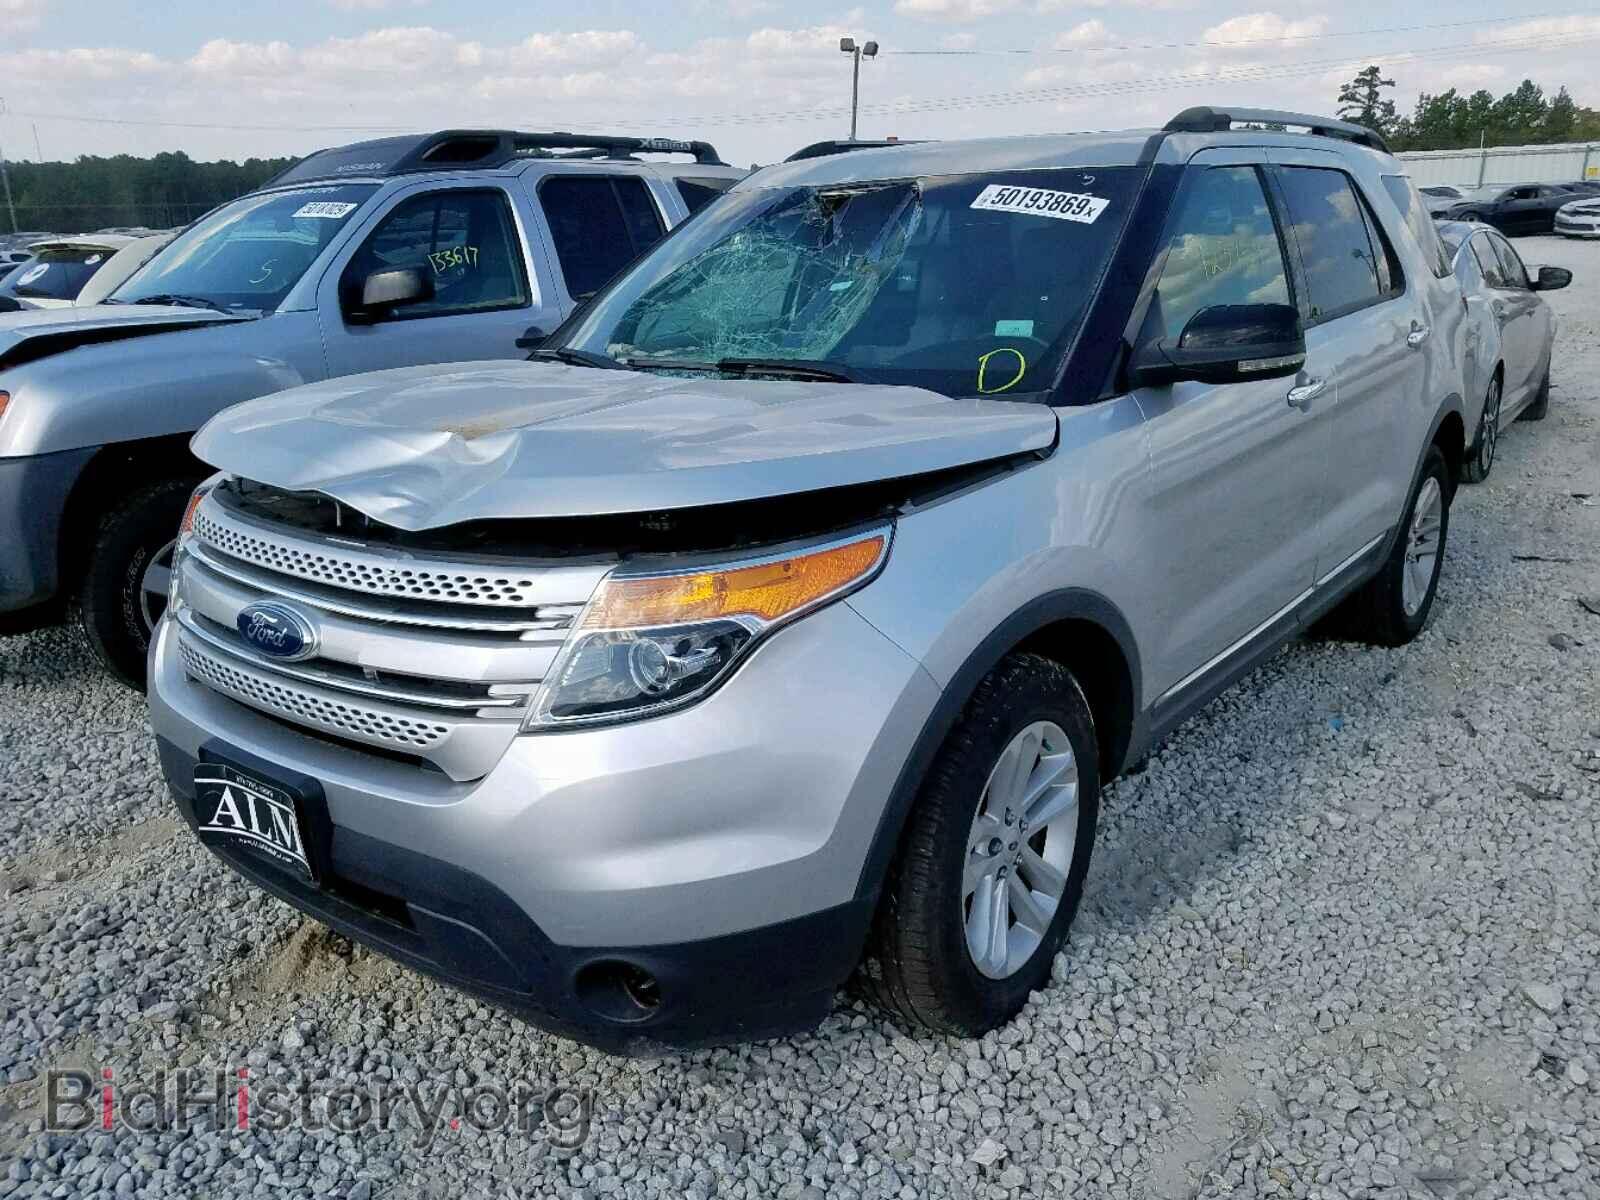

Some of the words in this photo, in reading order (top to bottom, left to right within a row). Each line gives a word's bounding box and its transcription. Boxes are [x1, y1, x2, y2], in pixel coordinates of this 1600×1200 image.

[427, 246, 478, 274] 133617
[978, 348, 1025, 394] D
[247, 611, 287, 648] Ford
